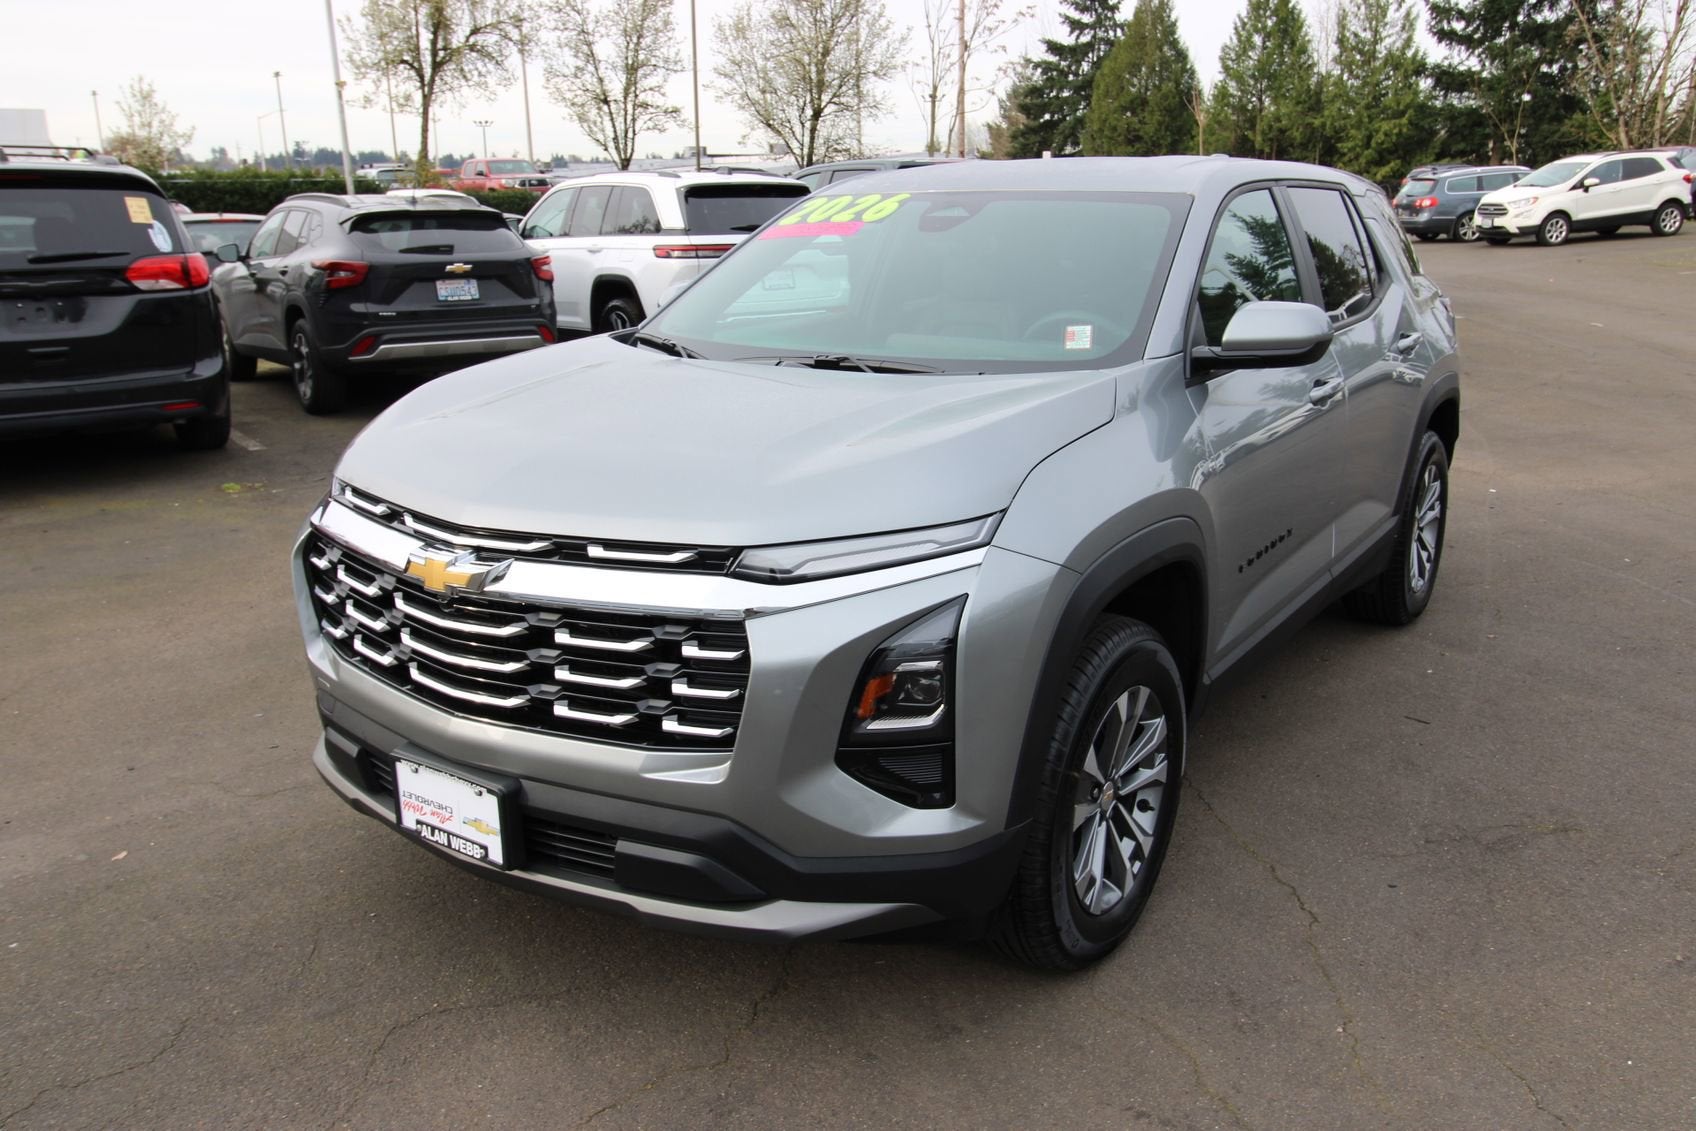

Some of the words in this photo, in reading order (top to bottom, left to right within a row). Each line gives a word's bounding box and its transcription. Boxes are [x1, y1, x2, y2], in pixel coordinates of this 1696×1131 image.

[777, 193, 912, 226] 2026
[402, 790, 454, 815] CHEVROLET
[421, 824, 448, 846] ALAN
[450, 834, 481, 859] WEBB
